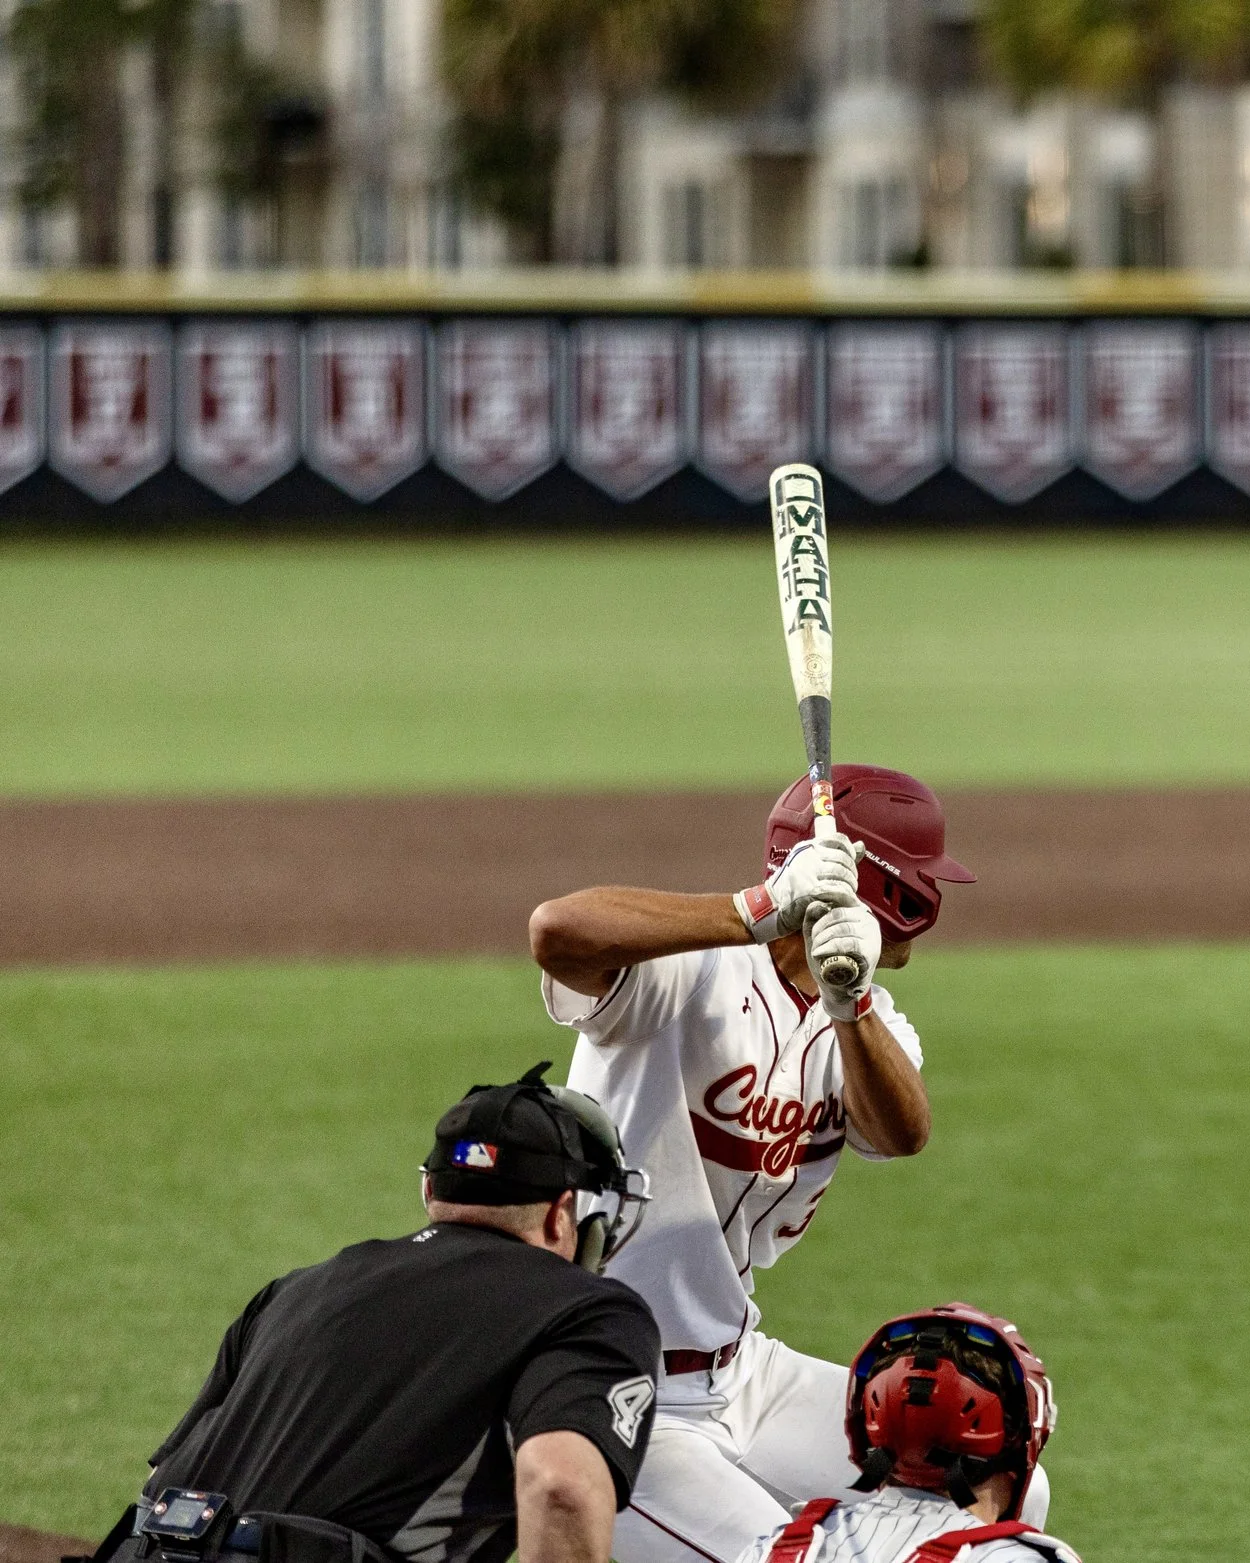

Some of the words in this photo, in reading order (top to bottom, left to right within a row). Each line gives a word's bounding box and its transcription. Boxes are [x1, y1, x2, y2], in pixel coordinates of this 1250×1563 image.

[775, 474, 831, 636] OMAHA
[865, 850, 901, 876] AWLINGS
[704, 1065, 846, 1178] Cougar
[607, 1375, 655, 1449] 4
